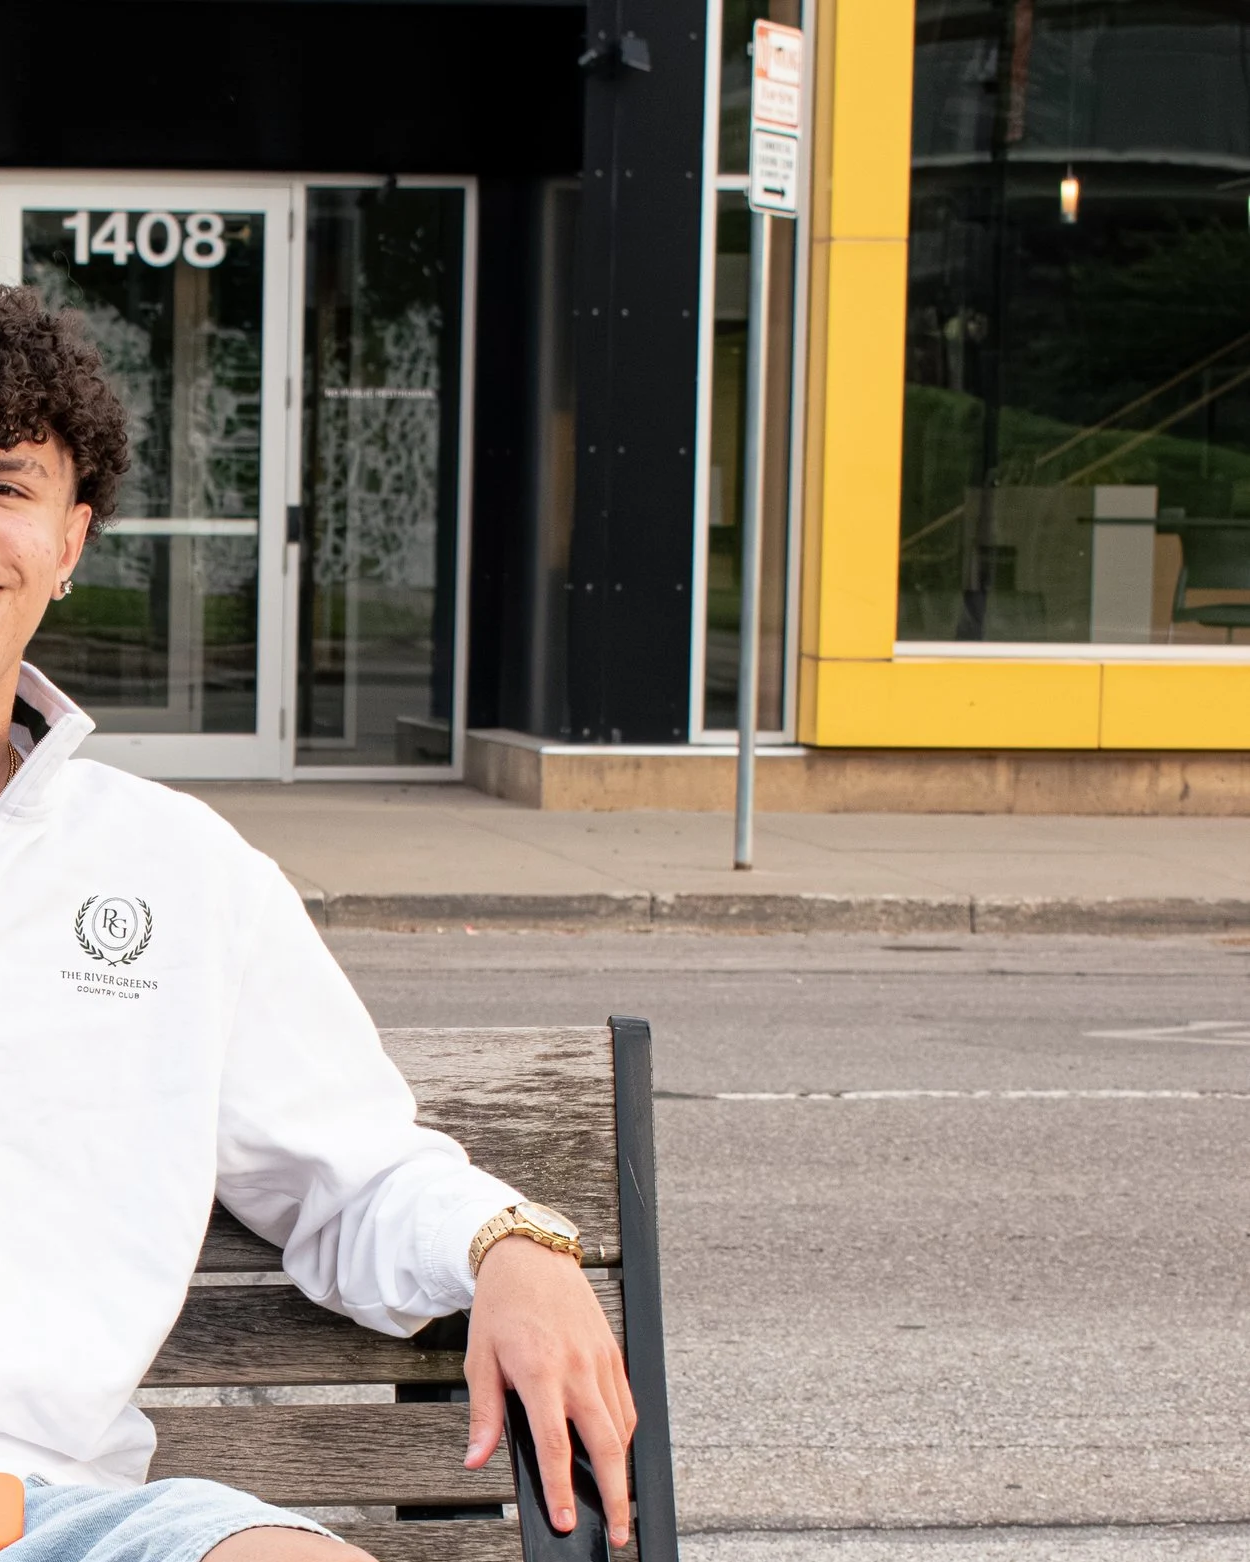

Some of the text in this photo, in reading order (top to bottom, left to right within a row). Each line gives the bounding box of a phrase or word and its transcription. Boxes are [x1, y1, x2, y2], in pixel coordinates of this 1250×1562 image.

[62, 210, 227, 269] 1408
[60, 970, 82, 981] THE
[77, 985, 140, 1000] COUNTRY CLUB
